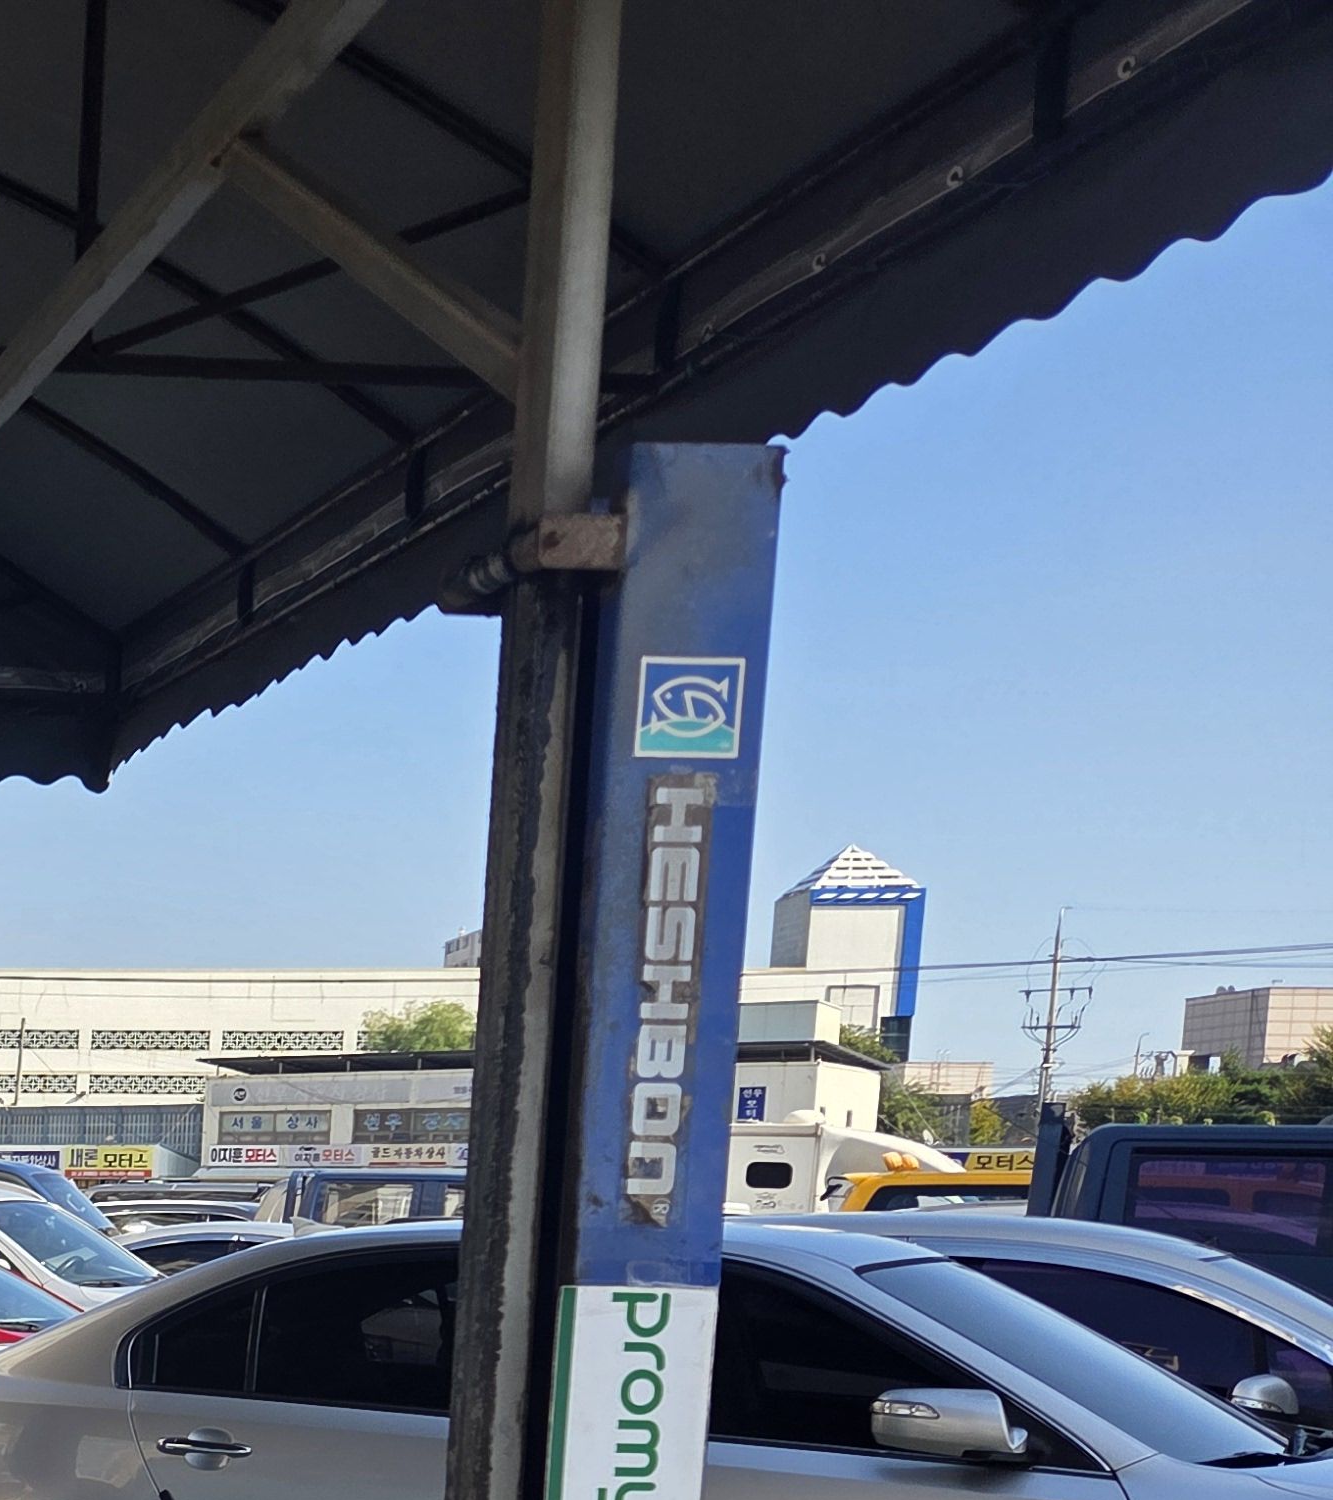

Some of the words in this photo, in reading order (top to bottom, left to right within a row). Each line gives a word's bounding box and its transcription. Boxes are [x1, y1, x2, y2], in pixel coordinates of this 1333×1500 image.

[625, 784, 704, 1198] HESHBON
[231, 1116, 263, 1129] 서울
[286, 1115, 319, 1129] 상사
[69, 1148, 99, 1168] 새론
[103, 1153, 149, 1168] 모터스
[211, 1147, 242, 1163] 이지훈
[244, 1147, 277, 1163] 모터스
[322, 1149, 355, 1162] 모터스
[973, 1154, 1035, 1171] 모터스
